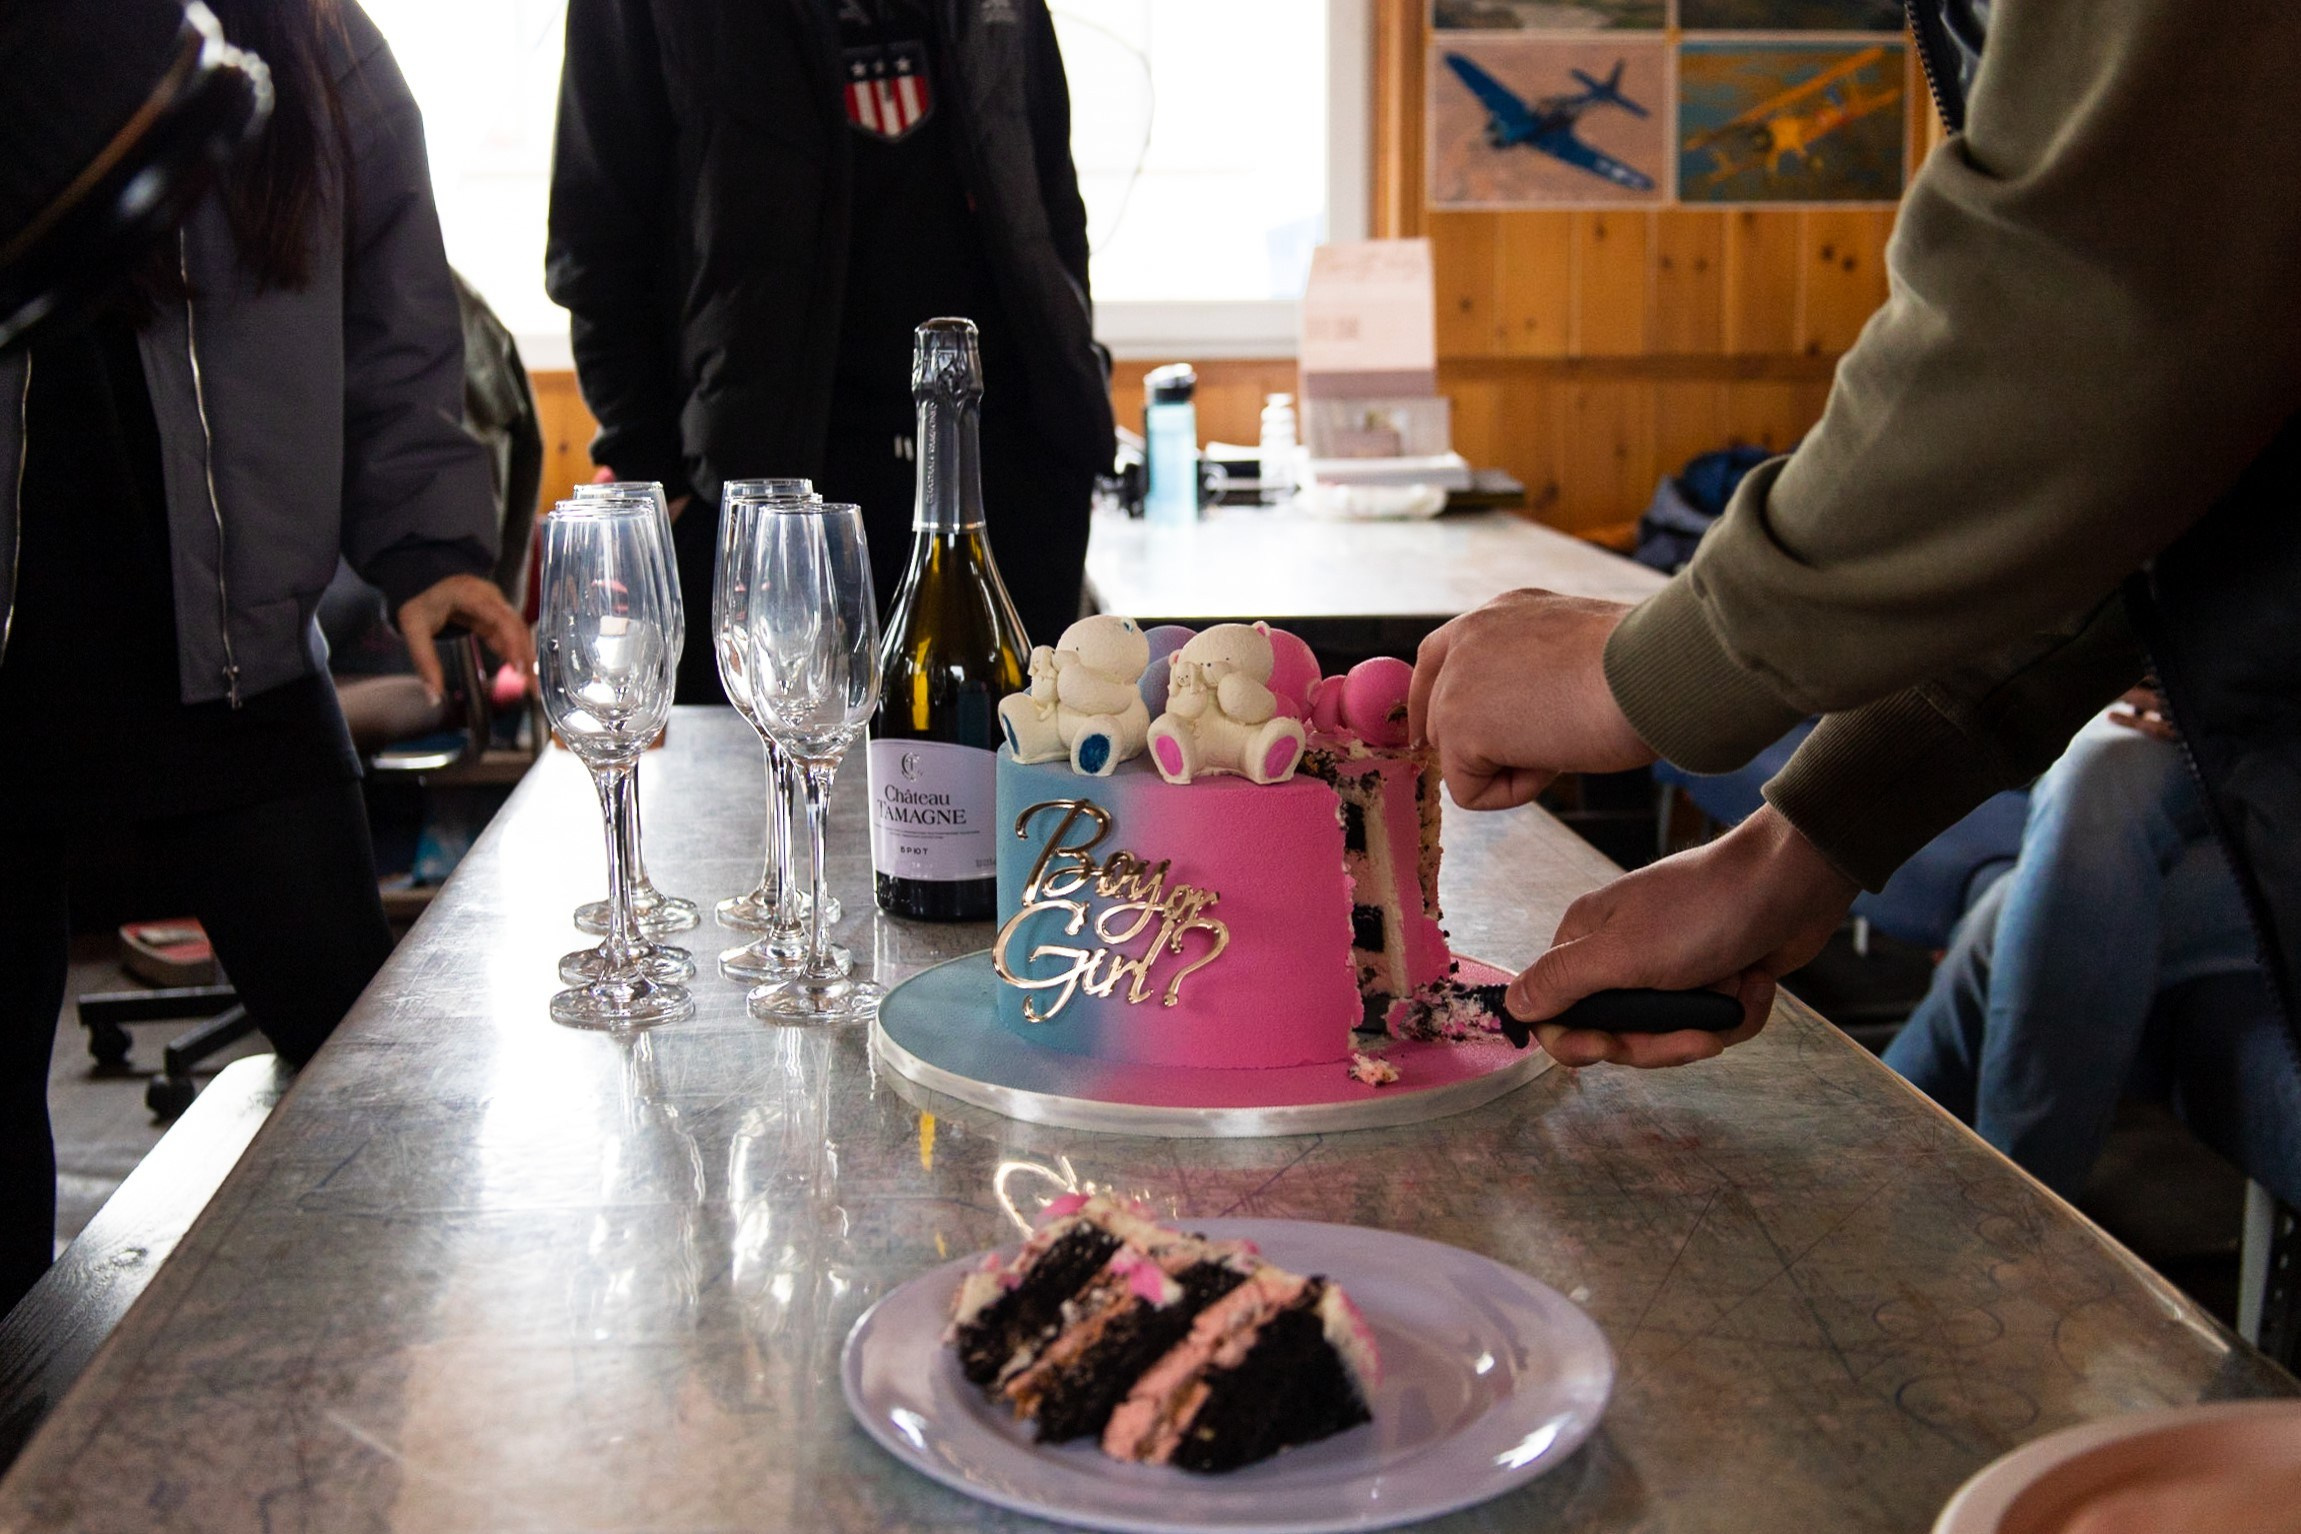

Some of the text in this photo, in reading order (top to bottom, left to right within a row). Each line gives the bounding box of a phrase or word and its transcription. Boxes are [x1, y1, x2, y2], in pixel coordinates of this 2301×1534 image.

[884, 784, 950, 806] Château
[877, 799, 967, 825] TAMAGNE
[1015, 798, 1221, 944] Boy or
